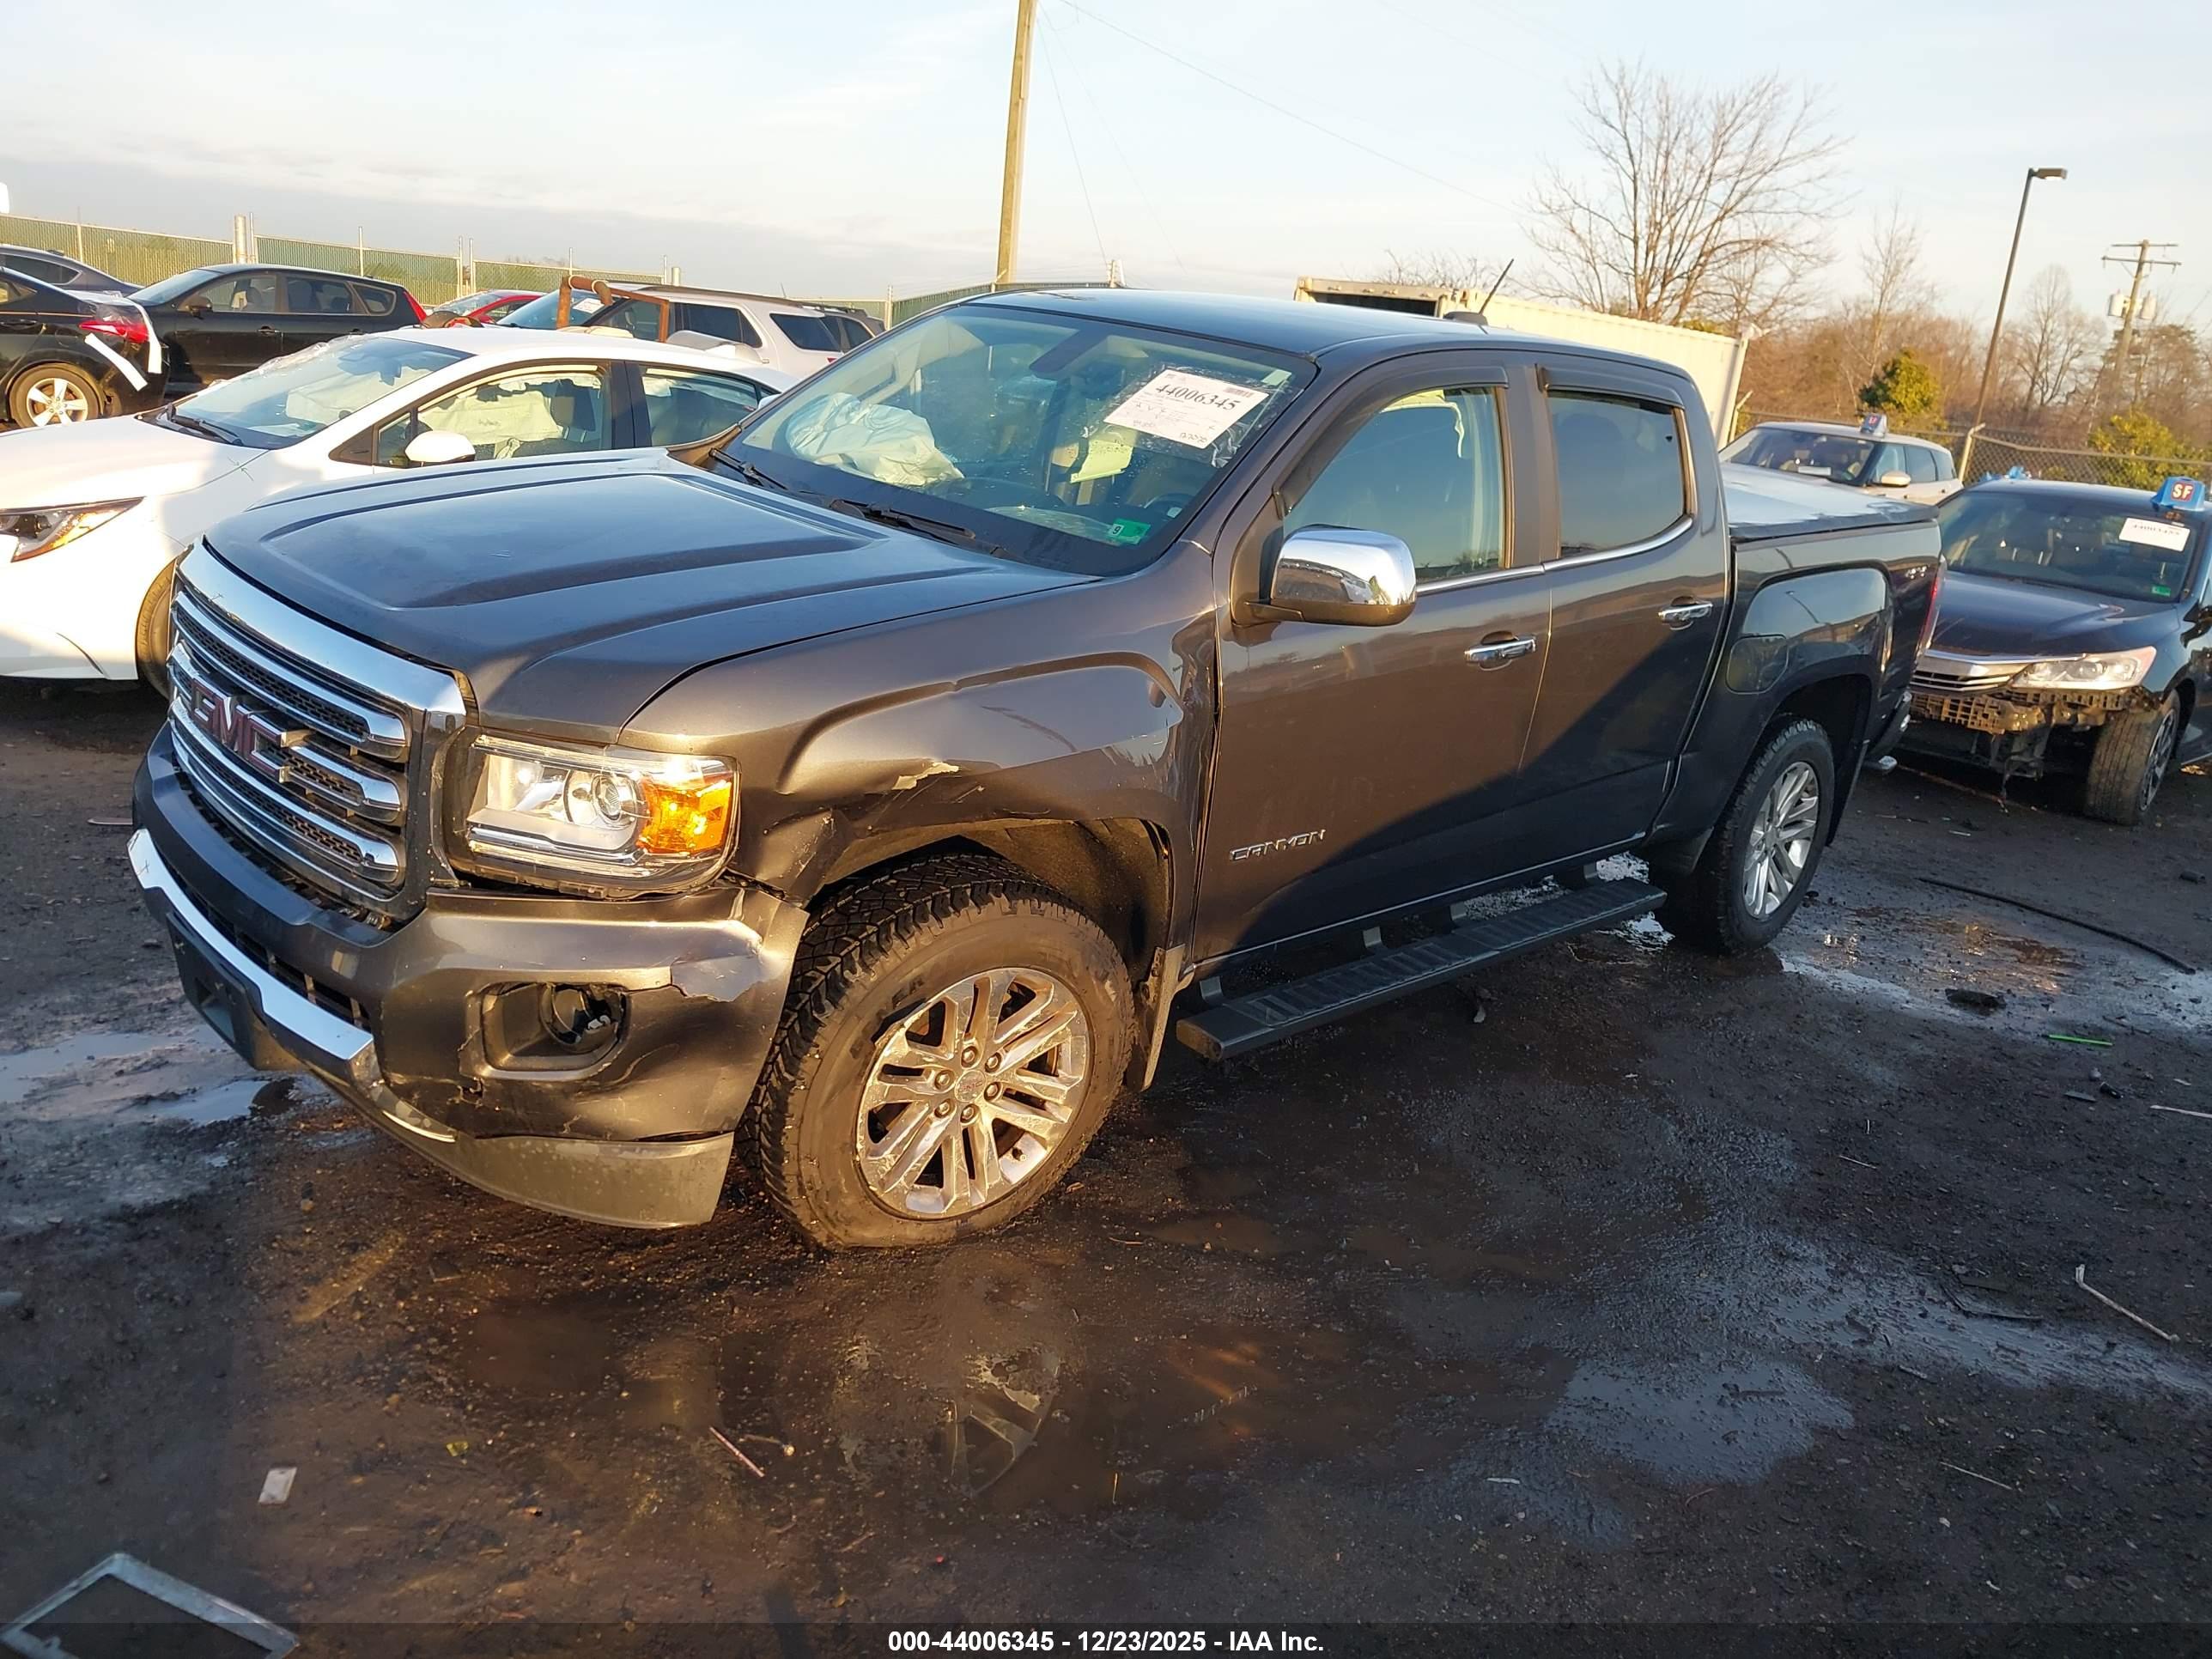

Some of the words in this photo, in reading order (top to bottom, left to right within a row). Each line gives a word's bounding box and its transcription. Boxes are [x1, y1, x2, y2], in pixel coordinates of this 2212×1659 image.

[1155, 383, 1242, 411] 44006345
[190, 677, 287, 783] GMC
[1230, 829, 1326, 861] CANYON
